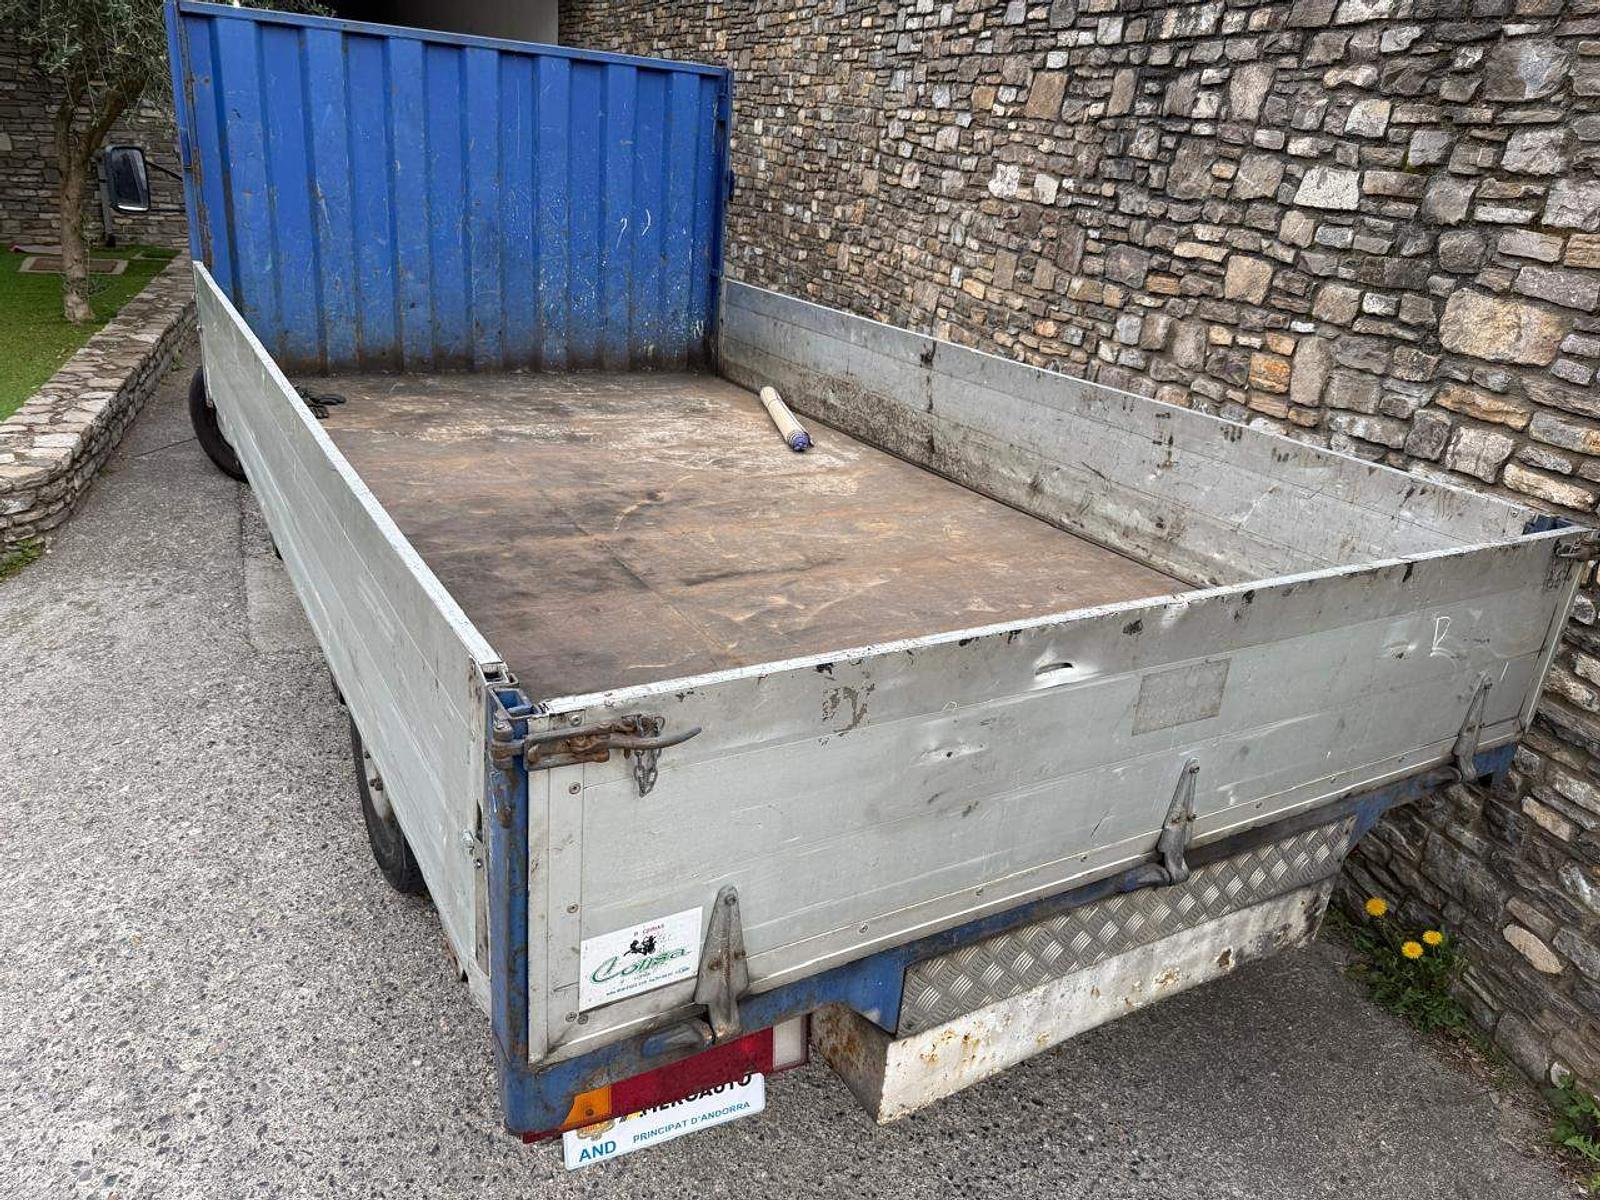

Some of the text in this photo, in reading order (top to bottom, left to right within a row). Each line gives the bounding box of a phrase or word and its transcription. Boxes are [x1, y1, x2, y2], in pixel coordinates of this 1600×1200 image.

[633, 1101, 751, 1144] PRINCIPAT D'ANDORRA
[578, 1140, 617, 1163] AND
